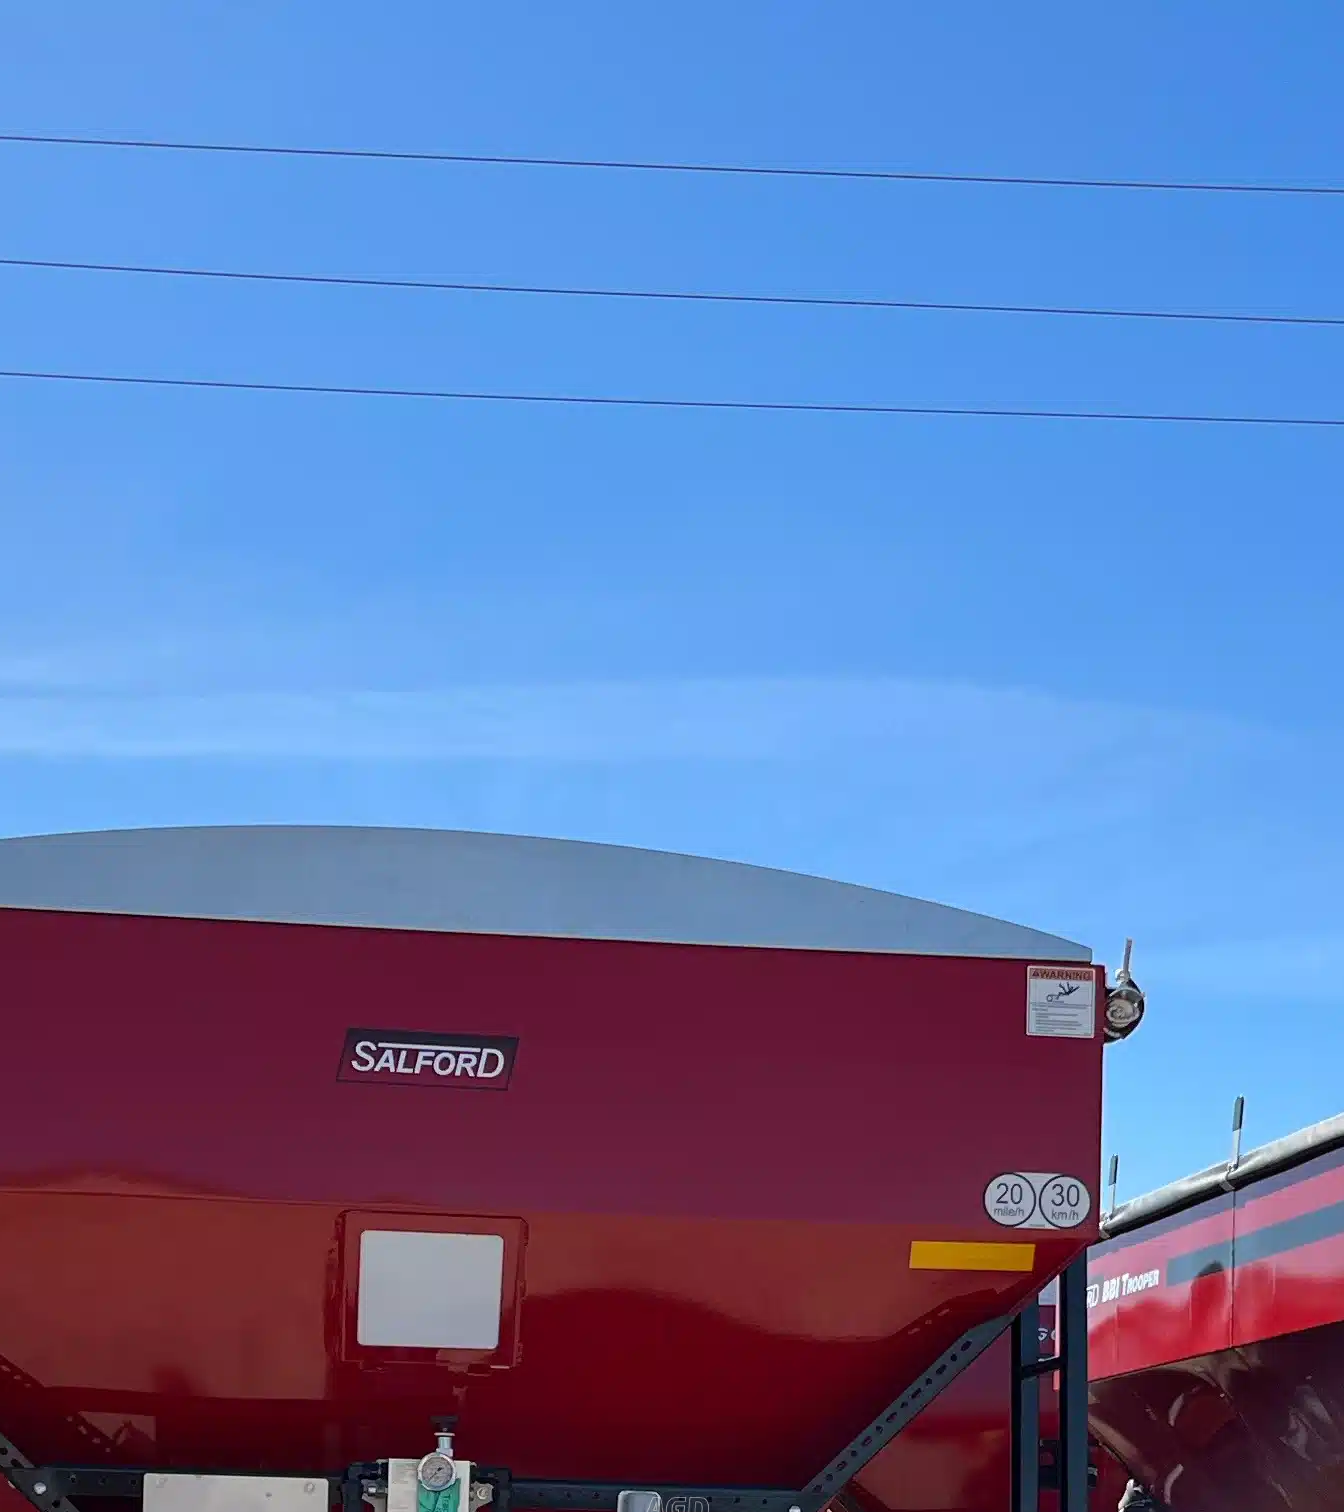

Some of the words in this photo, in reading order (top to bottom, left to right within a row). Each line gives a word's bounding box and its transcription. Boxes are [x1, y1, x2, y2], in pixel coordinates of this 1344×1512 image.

[1040, 969, 1091, 981] WARNING
[351, 1041, 505, 1078] SALFORD
[995, 1183, 1023, 1205] 20
[1051, 1183, 1080, 1207] 30
[993, 1206, 1025, 1217] mile/h
[1051, 1210, 1079, 1221] km/h
